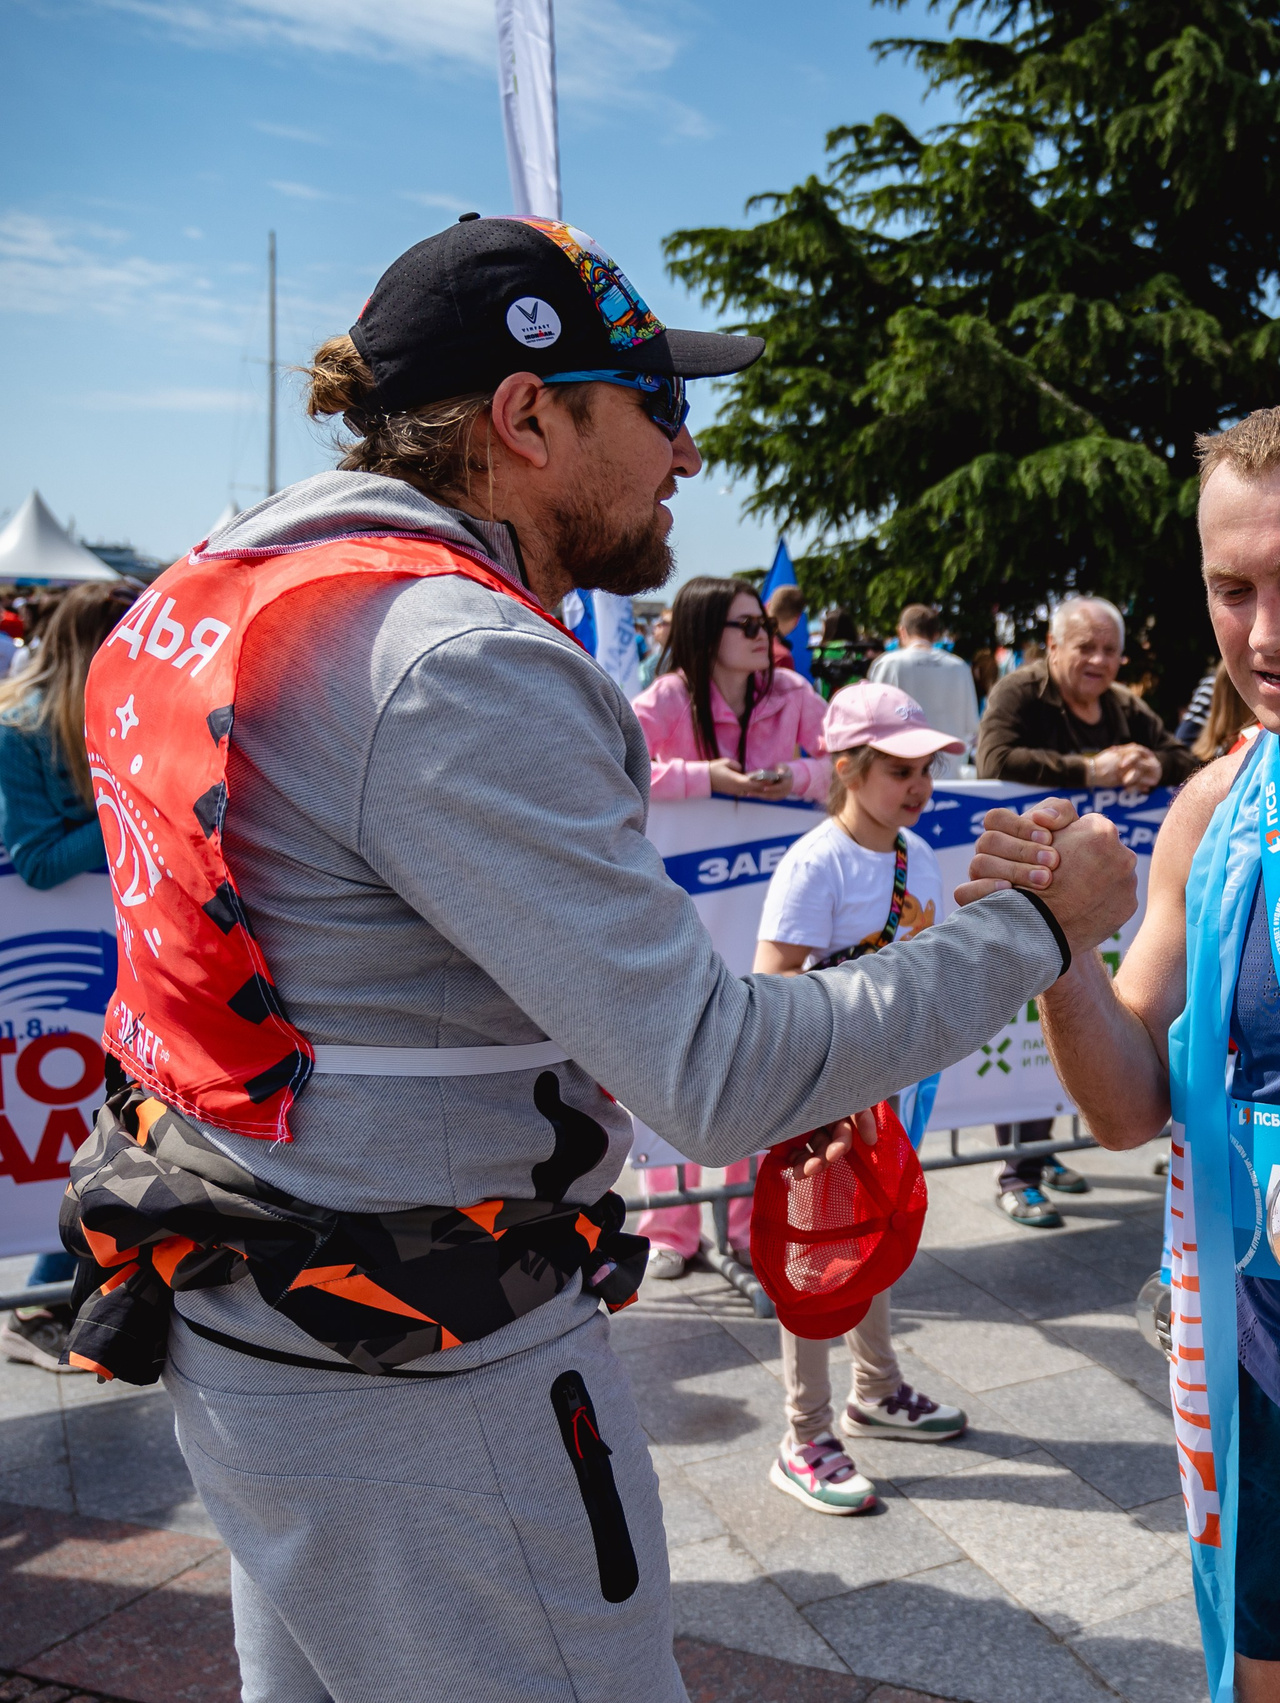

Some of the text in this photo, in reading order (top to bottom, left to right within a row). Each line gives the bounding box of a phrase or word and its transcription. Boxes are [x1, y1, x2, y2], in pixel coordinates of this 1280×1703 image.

[1265, 781, 1279, 827] ПСБ
[0, 1018, 43, 1041] 1.8
[1253, 1112, 1280, 1127] ПСБ
